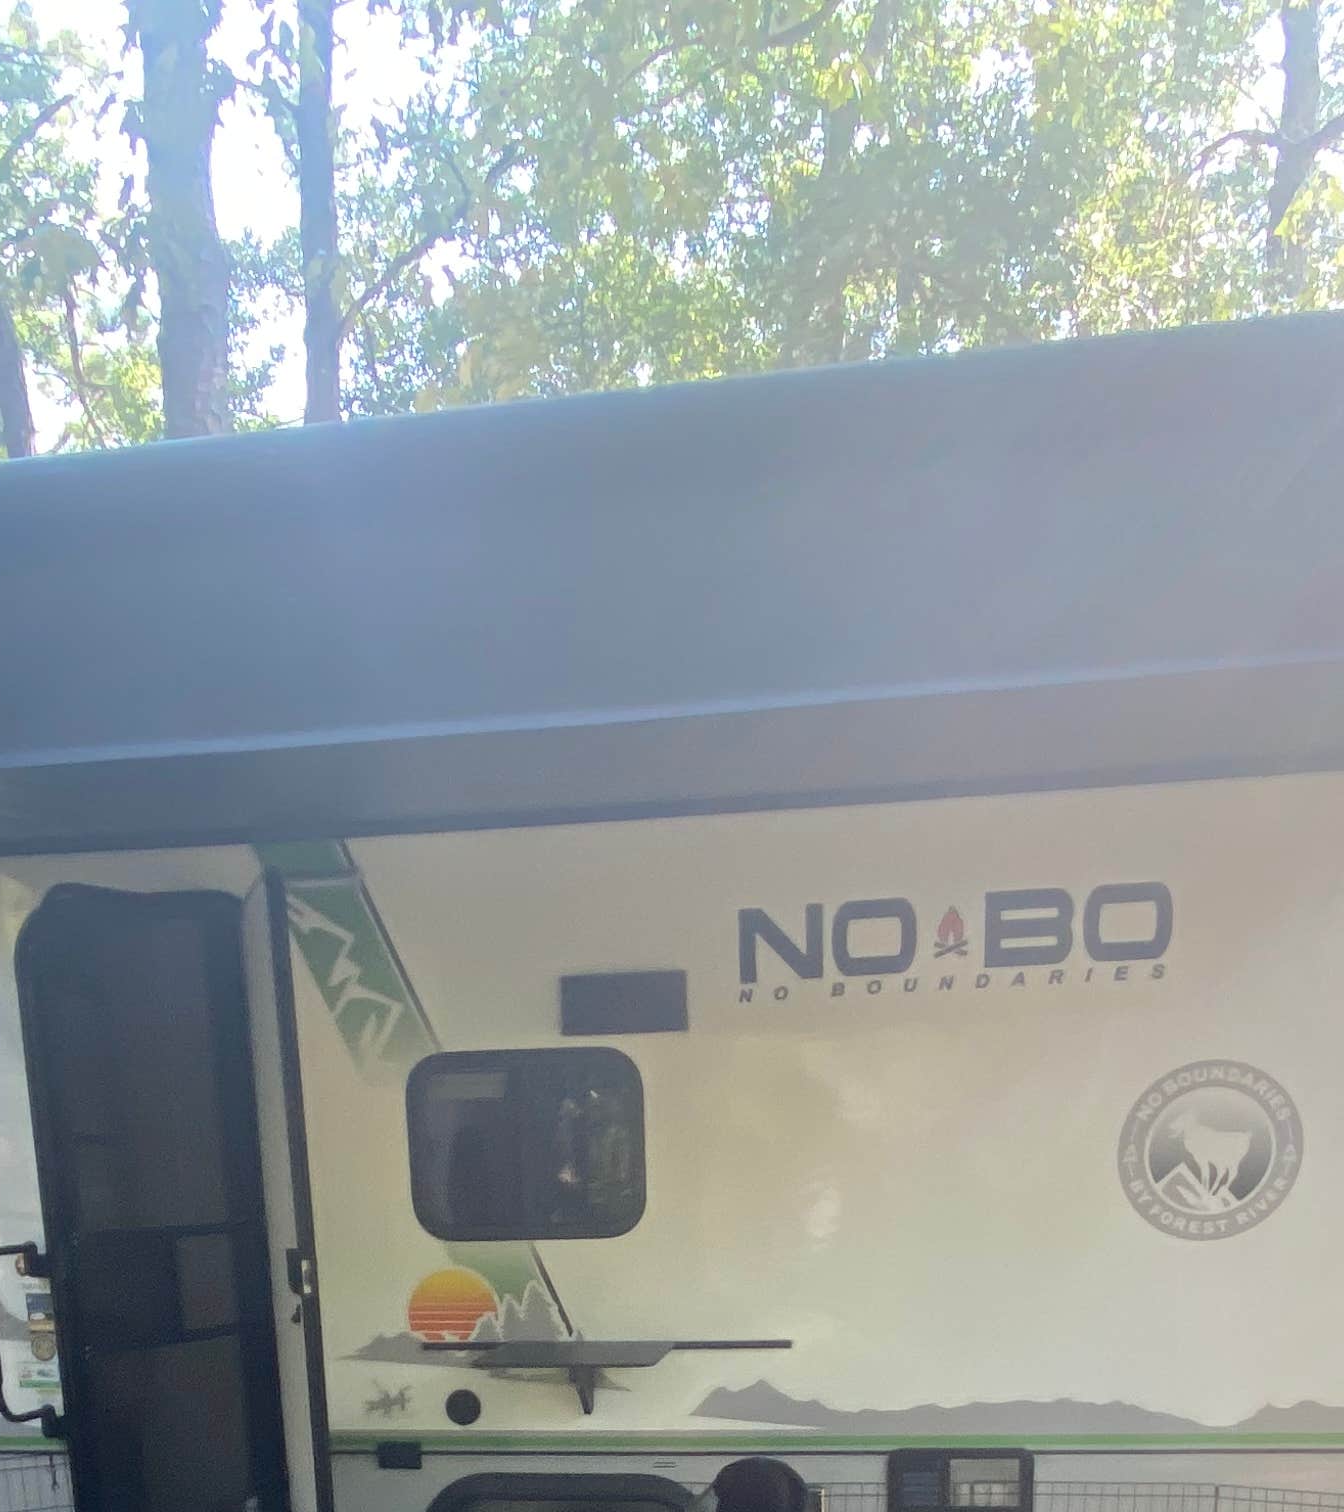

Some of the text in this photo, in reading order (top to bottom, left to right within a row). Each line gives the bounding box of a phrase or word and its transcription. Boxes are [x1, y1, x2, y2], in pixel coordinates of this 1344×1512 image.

[737, 881, 1174, 985] NO BO
[738, 963, 1167, 1003] NO BOUNDARIES
[1135, 1066, 1292, 1121] NO BOUNDARIES
[1149, 1204, 1229, 1234] FOREST
